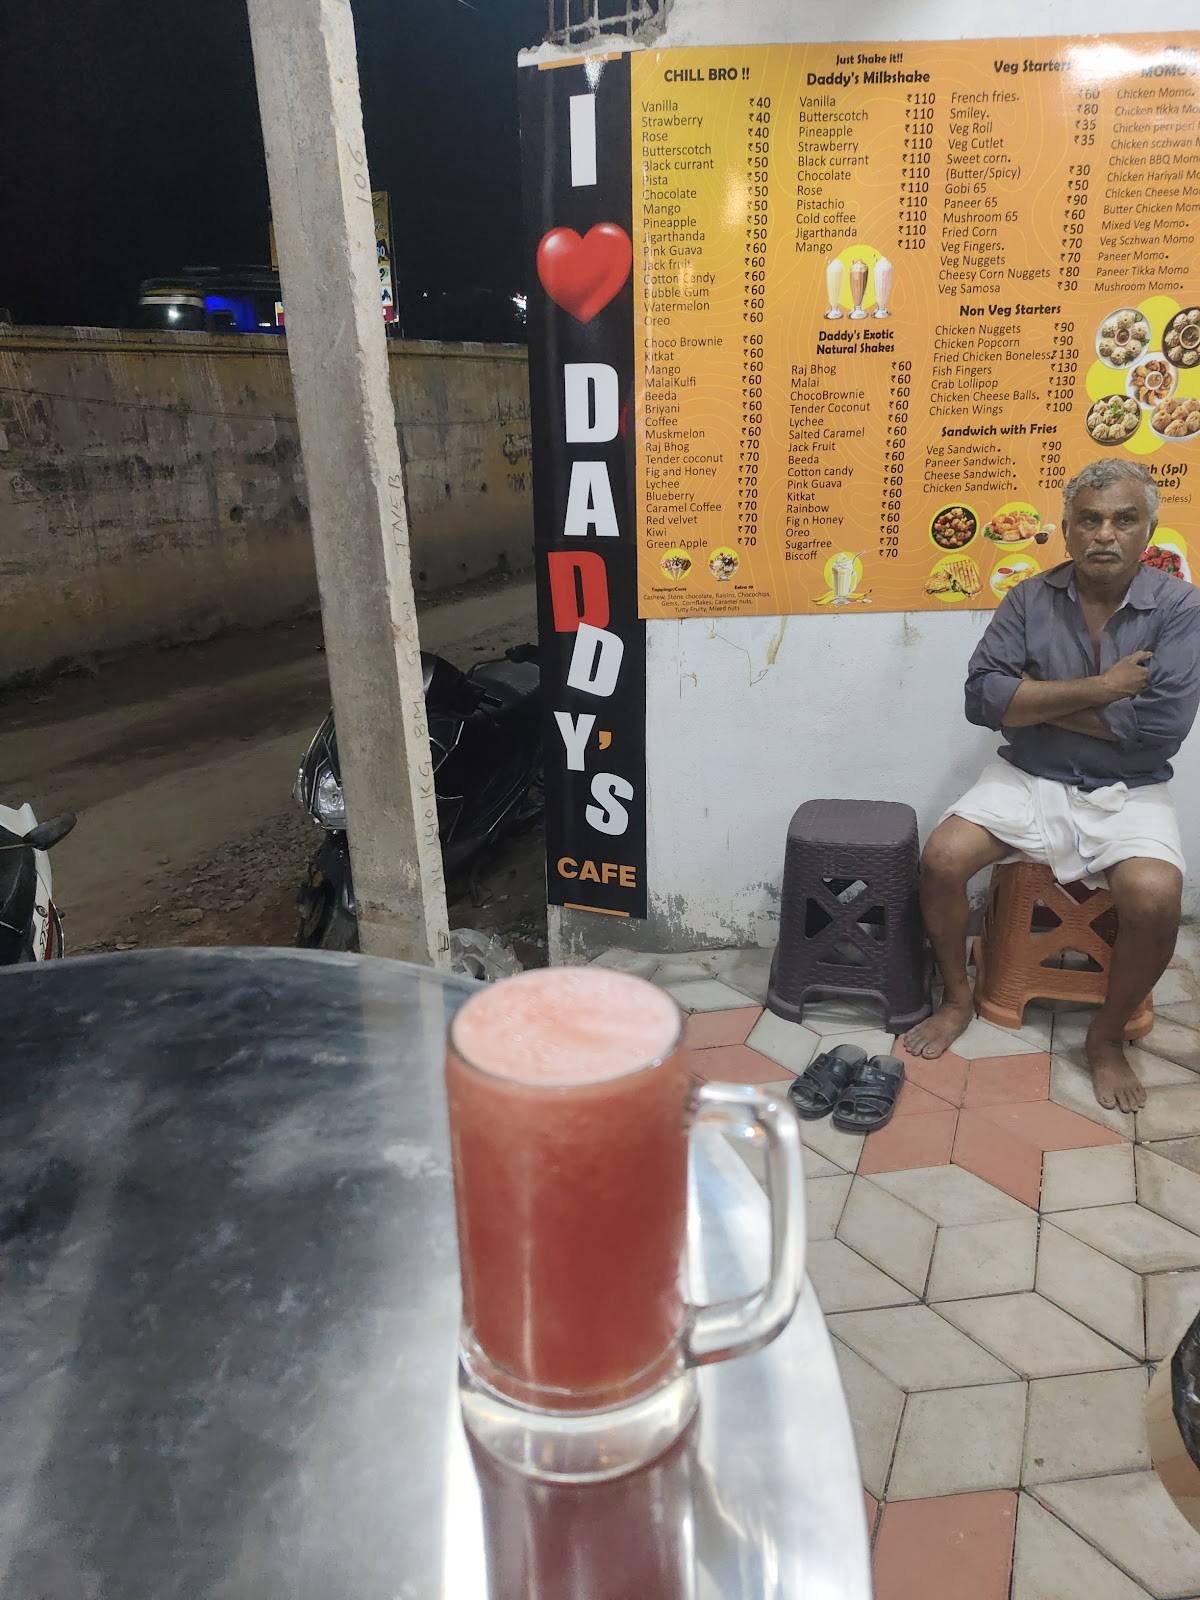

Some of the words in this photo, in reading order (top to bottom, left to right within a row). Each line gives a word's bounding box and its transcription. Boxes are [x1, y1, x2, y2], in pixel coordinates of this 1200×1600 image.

[836, 55, 854, 65] Just
[857, 54, 886, 64] Shake
[890, 53, 903, 64] it!!
[994, 60, 1018, 74] Veg
[664, 69, 704, 82] CHILL
[708, 68, 737, 81] BRO
[806, 73, 859, 87] Daddy's
[864, 71, 930, 84] Milkshake
[800, 96, 836, 107] Vanilla
[951, 92, 989, 103] French
[992, 91, 1020, 102] fries.
[642, 100, 678, 113] Vanilla
[800, 110, 869, 122] Butterscotch
[950, 108, 989, 121] Smiley.
[642, 115, 703, 128] Strawberry
[799, 125, 853, 138] Pineapple
[950, 123, 969, 136] Veg
[972, 122, 992, 133] Roll
[1075, 119, 1096, 131] ₹35
[569, 93, 598, 187] I
[642, 131, 668, 142] Rose
[798, 141, 859, 153] Strawberry
[948, 138, 968, 151] Veg
[971, 138, 1003, 149] Cutlet
[642, 144, 711, 157] Butterscotch
[798, 170, 851, 181] Chocolate
[798, 186, 822, 195] Rose
[945, 183, 971, 194] Gobi
[973, 183, 987, 193] 65
[944, 198, 982, 209] Paneer
[985, 197, 998, 208] 65
[643, 203, 681, 215] Mango
[943, 212, 1002, 223] Mushroom
[1005, 211, 1018, 222] 65
[643, 217, 696, 229] Pineapple
[1102, 220, 1131, 230] Mixed
[1134, 220, 1151, 231] Veg
[1153, 220, 1189, 228] Momo.
[942, 227, 969, 238] Fried
[972, 226, 997, 237] Corn
[1100, 237, 1117, 247] Veg
[1163, 235, 1194, 243] Momo
[796, 242, 833, 253] Mango
[939, 269, 976, 281] Cheesy
[979, 269, 1004, 280] Corn
[1008, 268, 1051, 279] Nuggets
[1096, 268, 1129, 276] Paneer
[1132, 266, 1155, 275] Tikka
[1158, 266, 1189, 274] Momo
[1095, 282, 1145, 291] Mushroom
[1149, 281, 1183, 290] Momo.
[960, 305, 984, 317] Non
[988, 305, 1011, 317] Veg
[1015, 304, 1061, 315] Starters
[935, 325, 975, 336] Chicken
[979, 324, 1021, 336] Nuggets
[819, 331, 860, 342] Daddy's
[864, 330, 894, 340] Exotic
[645, 338, 676, 348] Choco
[680, 337, 722, 347] Brownie
[817, 344, 857, 354] Natural
[860, 343, 895, 353] Shakes
[645, 352, 674, 361] Kitkat
[932, 366, 952, 376] Fish
[955, 365, 992, 377] Fingers
[645, 391, 676, 401] Beeda
[791, 390, 865, 401] ChocoBrownie
[645, 404, 680, 415] Briyani
[790, 404, 825, 414] Tender
[828, 403, 870, 412] Coconut
[929, 405, 969, 416] Chicken
[972, 405, 1003, 416] Wings
[645, 417, 678, 426] Coffee
[789, 417, 824, 428] Lychee
[645, 428, 705, 439] Muskmelon
[942, 425, 997, 437] Sandwich
[1000, 424, 1026, 434] with
[1030, 424, 1057, 434] Fries
[646, 455, 680, 464] Tender
[683, 454, 723, 463] coconut
[788, 455, 819, 464] Beeda
[925, 458, 960, 468] Paneer
[964, 456, 1016, 466] Sandwich.
[1161, 464, 1188, 475] (Spl)
[646, 480, 680, 490] Lychee
[788, 480, 809, 489] Pink
[811, 479, 842, 488] Guava
[646, 492, 694, 502] Blueberry
[787, 492, 815, 501] Kitkat
[646, 503, 687, 513] Caramel
[690, 502, 721, 512] Coffee
[787, 504, 829, 513] Rainbow
[647, 516, 664, 525] Red
[668, 515, 697, 524] velvet
[647, 540, 676, 548] Green
[680, 538, 708, 549] Apple
[786, 540, 832, 550] Sugarfree
[786, 551, 817, 561] Biscoff
[547, 362, 634, 836] DADDY'S
[557, 856, 637, 888] CAFE
